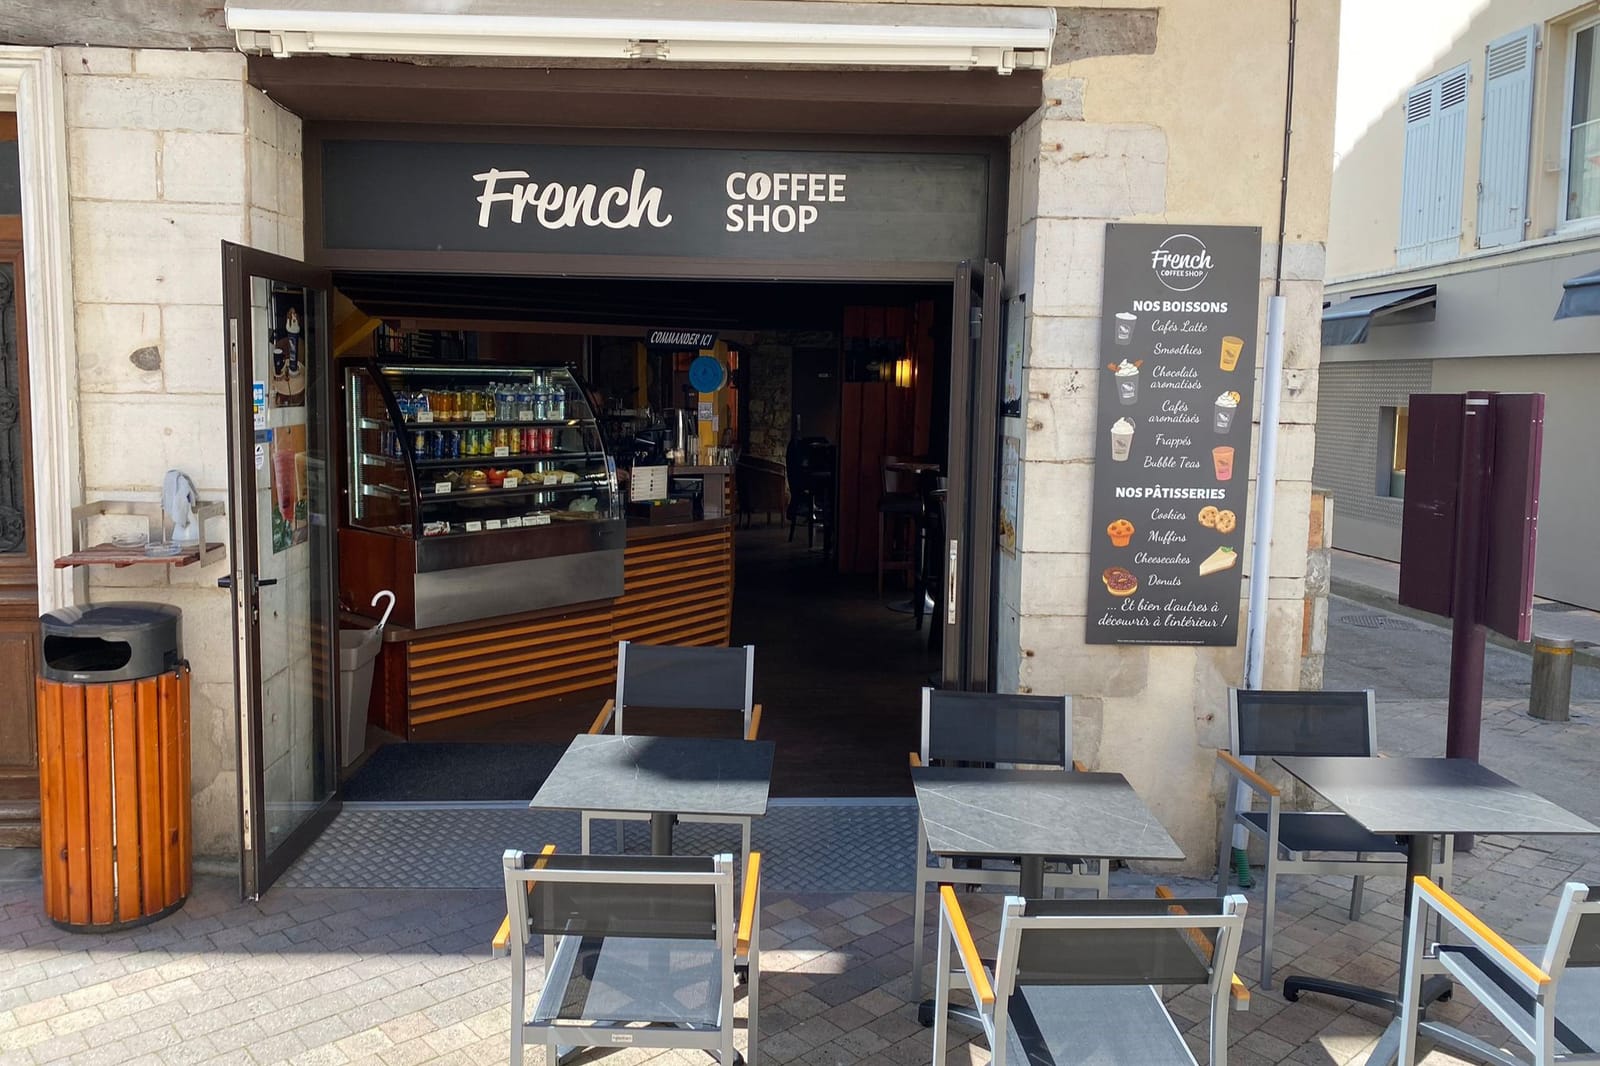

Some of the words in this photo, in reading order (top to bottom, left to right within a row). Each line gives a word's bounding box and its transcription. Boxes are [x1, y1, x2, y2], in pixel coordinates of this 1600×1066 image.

[726, 171, 847, 202] COFFEE
[473, 168, 672, 230] French
[726, 204, 818, 233] SHOP
[1151, 249, 1214, 270] French
[1160, 269, 1184, 277] COFFEE
[1133, 300, 1161, 312] NOS
[1162, 301, 1228, 313] BOISSONS
[1151, 320, 1178, 335] Cafés
[1180, 320, 1208, 333] Latte
[650, 331, 699, 344] COMMANDER
[699, 334, 713, 346] ICI
[1153, 342, 1203, 356] Smoothies
[1152, 365, 1198, 378] Chocolats
[1150, 378, 1202, 390] aromatisés
[1161, 400, 1189, 415] Cafés
[1148, 412, 1200, 424] aromatisés
[1155, 433, 1192, 448] Frappés
[1143, 456, 1176, 468] Bubble
[1178, 457, 1200, 469] Teas
[1115, 487, 1142, 498] NOS
[1144, 485, 1226, 499] PÂTISSERIES
[1151, 507, 1186, 521] Cookies
[1147, 530, 1187, 544] Muffins
[1134, 552, 1191, 565] Cheesecakes
[1148, 574, 1182, 587] Donuts
[1121, 597, 1136, 612] Et
[1137, 598, 1161, 612] bien
[1164, 599, 1209, 613] d'autres
[1210, 601, 1219, 613] à
[1098, 614, 1151, 627] découvrir
[1152, 616, 1162, 627] à
[1164, 614, 1219, 628] l'intérieur
